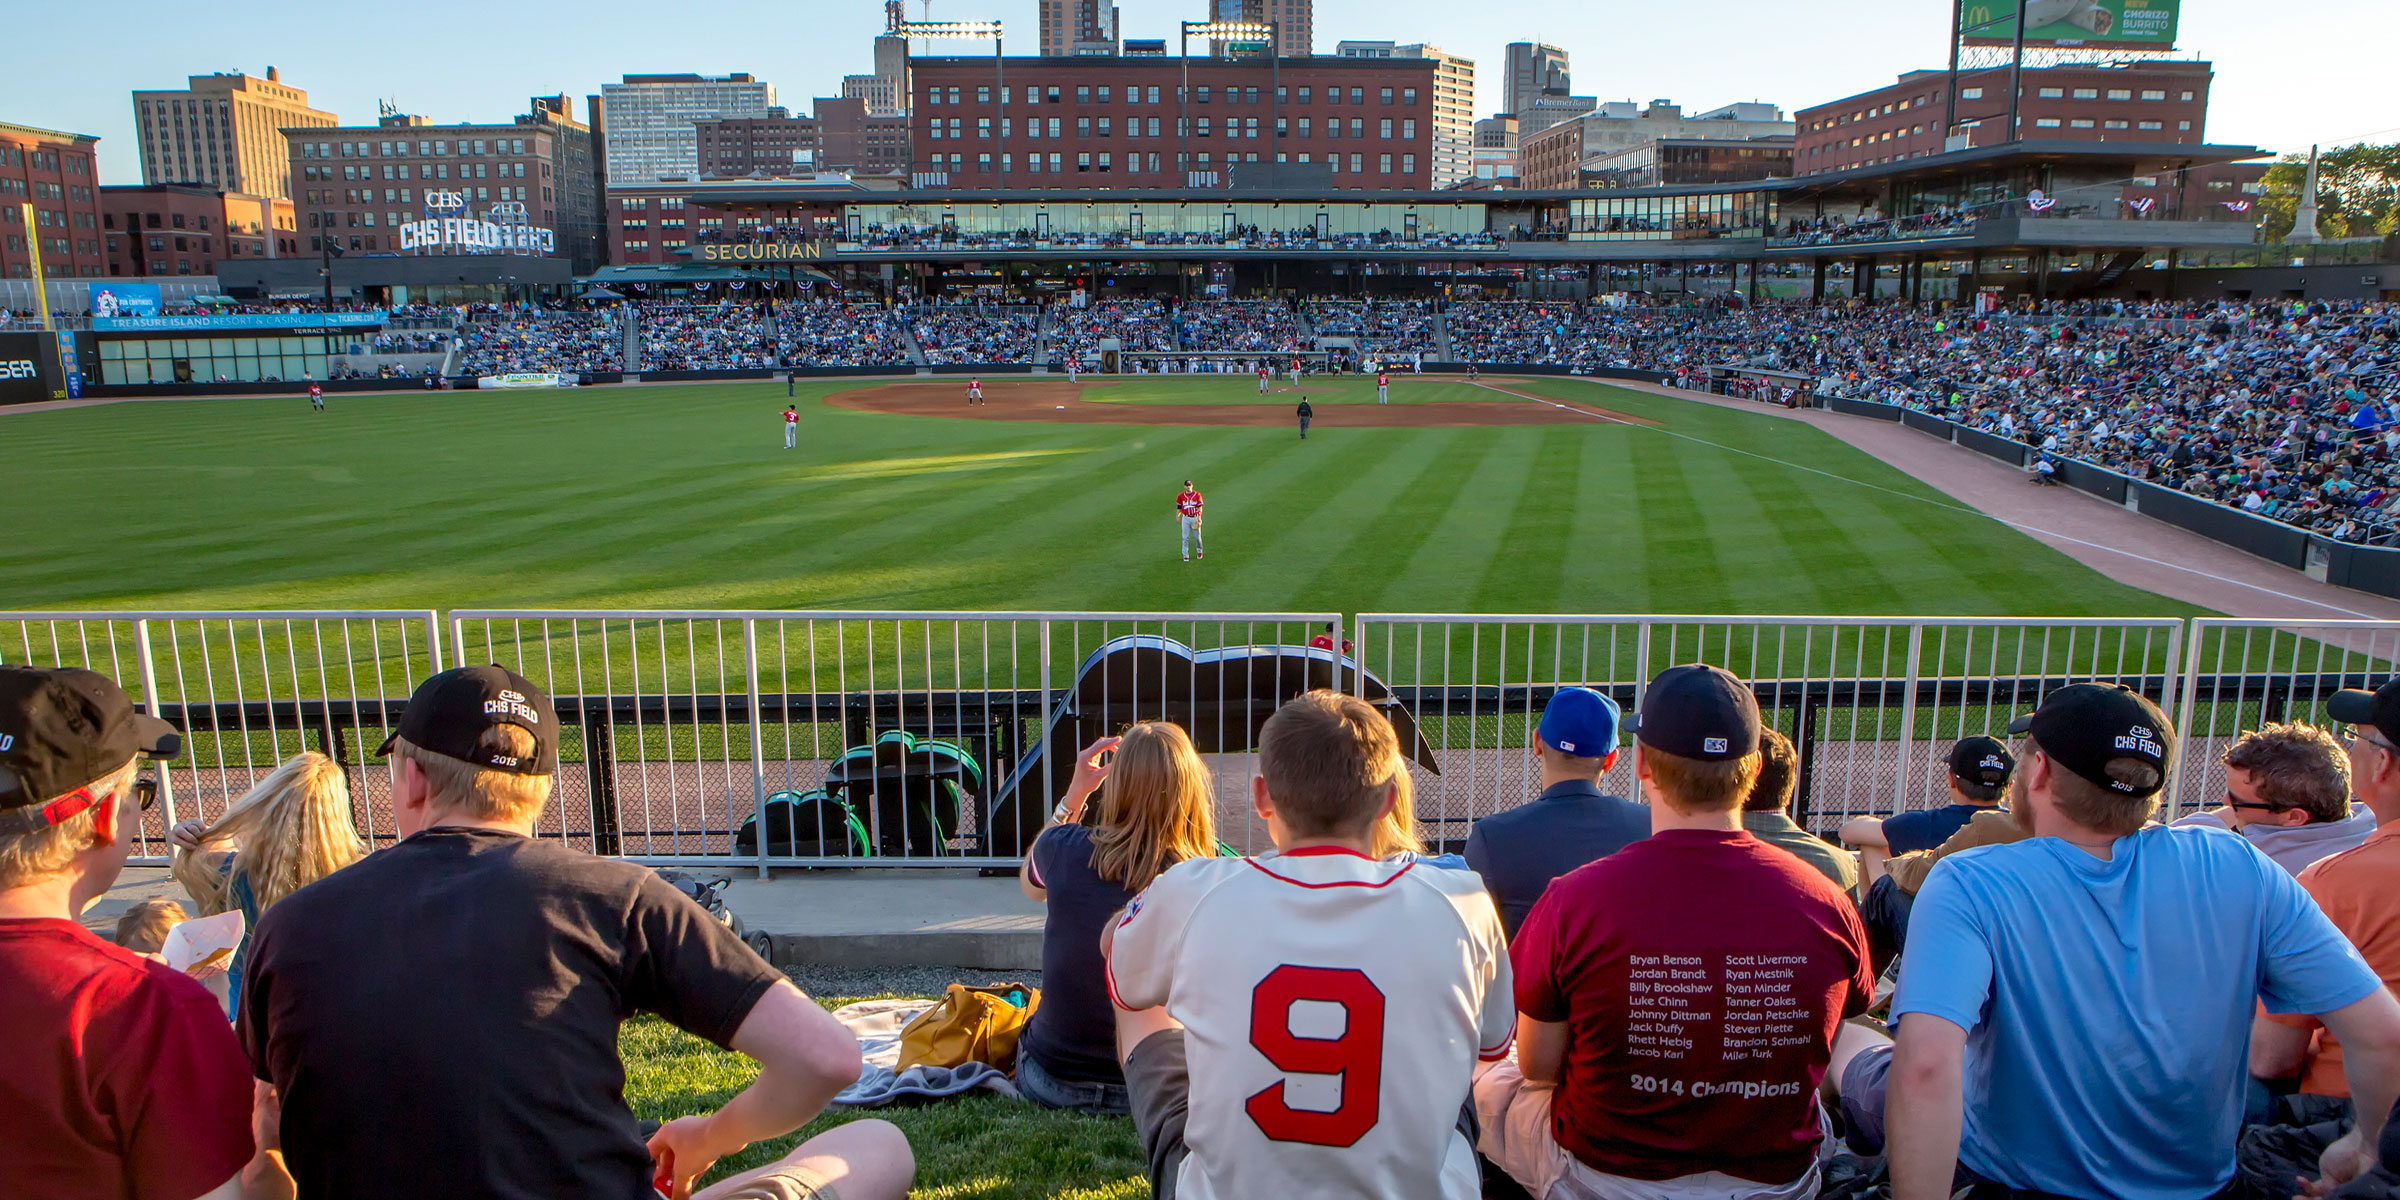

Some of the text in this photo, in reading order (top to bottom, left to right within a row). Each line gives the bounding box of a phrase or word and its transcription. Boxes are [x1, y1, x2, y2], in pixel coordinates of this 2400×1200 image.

[2122, 9, 2169, 19] CHORIZO
[2122, 20, 2169, 30] BURRITO
[426, 192, 463, 208] CHS
[400, 219, 440, 250] CHS
[445, 218, 499, 249] FIELD
[704, 243, 820, 260] SECURIAN
[111, 315, 306, 328] TREASURE ISLAND RESORT & CASINO
[53, 390, 65, 399] 320
[484, 700, 538, 724] CHS FIELD
[2132, 725, 2150, 736] CHS
[2115, 736, 2162, 759] CHS FIELD
[491, 755, 518, 767] 2015
[2111, 781, 2134, 792] 2015
[1630, 955, 1702, 967] Bryan Benson
[1726, 955, 1808, 966] Scott Livermore
[1629, 969, 1706, 979] Jordan Brandt
[1726, 968, 1794, 980] Ryan Mestnik
[1630, 983, 1713, 993] Billy Brookshaw
[1726, 983, 1791, 994] Ryan Minder
[1630, 996, 1688, 1006] Luke Chinn
[1725, 997, 1796, 1007] Tanner Oakes
[1629, 1010, 1711, 1021] Johnny Dittman
[1724, 1009, 1810, 1021] Jordan Petschke
[1628, 1023, 1684, 1035] Jack Duffy
[1724, 1023, 1793, 1034] Steven Piette
[1628, 1035, 1693, 1049] Rhett Hebig
[1723, 1035, 1811, 1047] Brandon Schmahl
[1245, 963, 1386, 1148] 9
[1628, 1047, 1660, 1057] Jacob
[1723, 1049, 1772, 1060] Miles Turk
[1630, 1074, 1800, 1100] 2014 Champions
